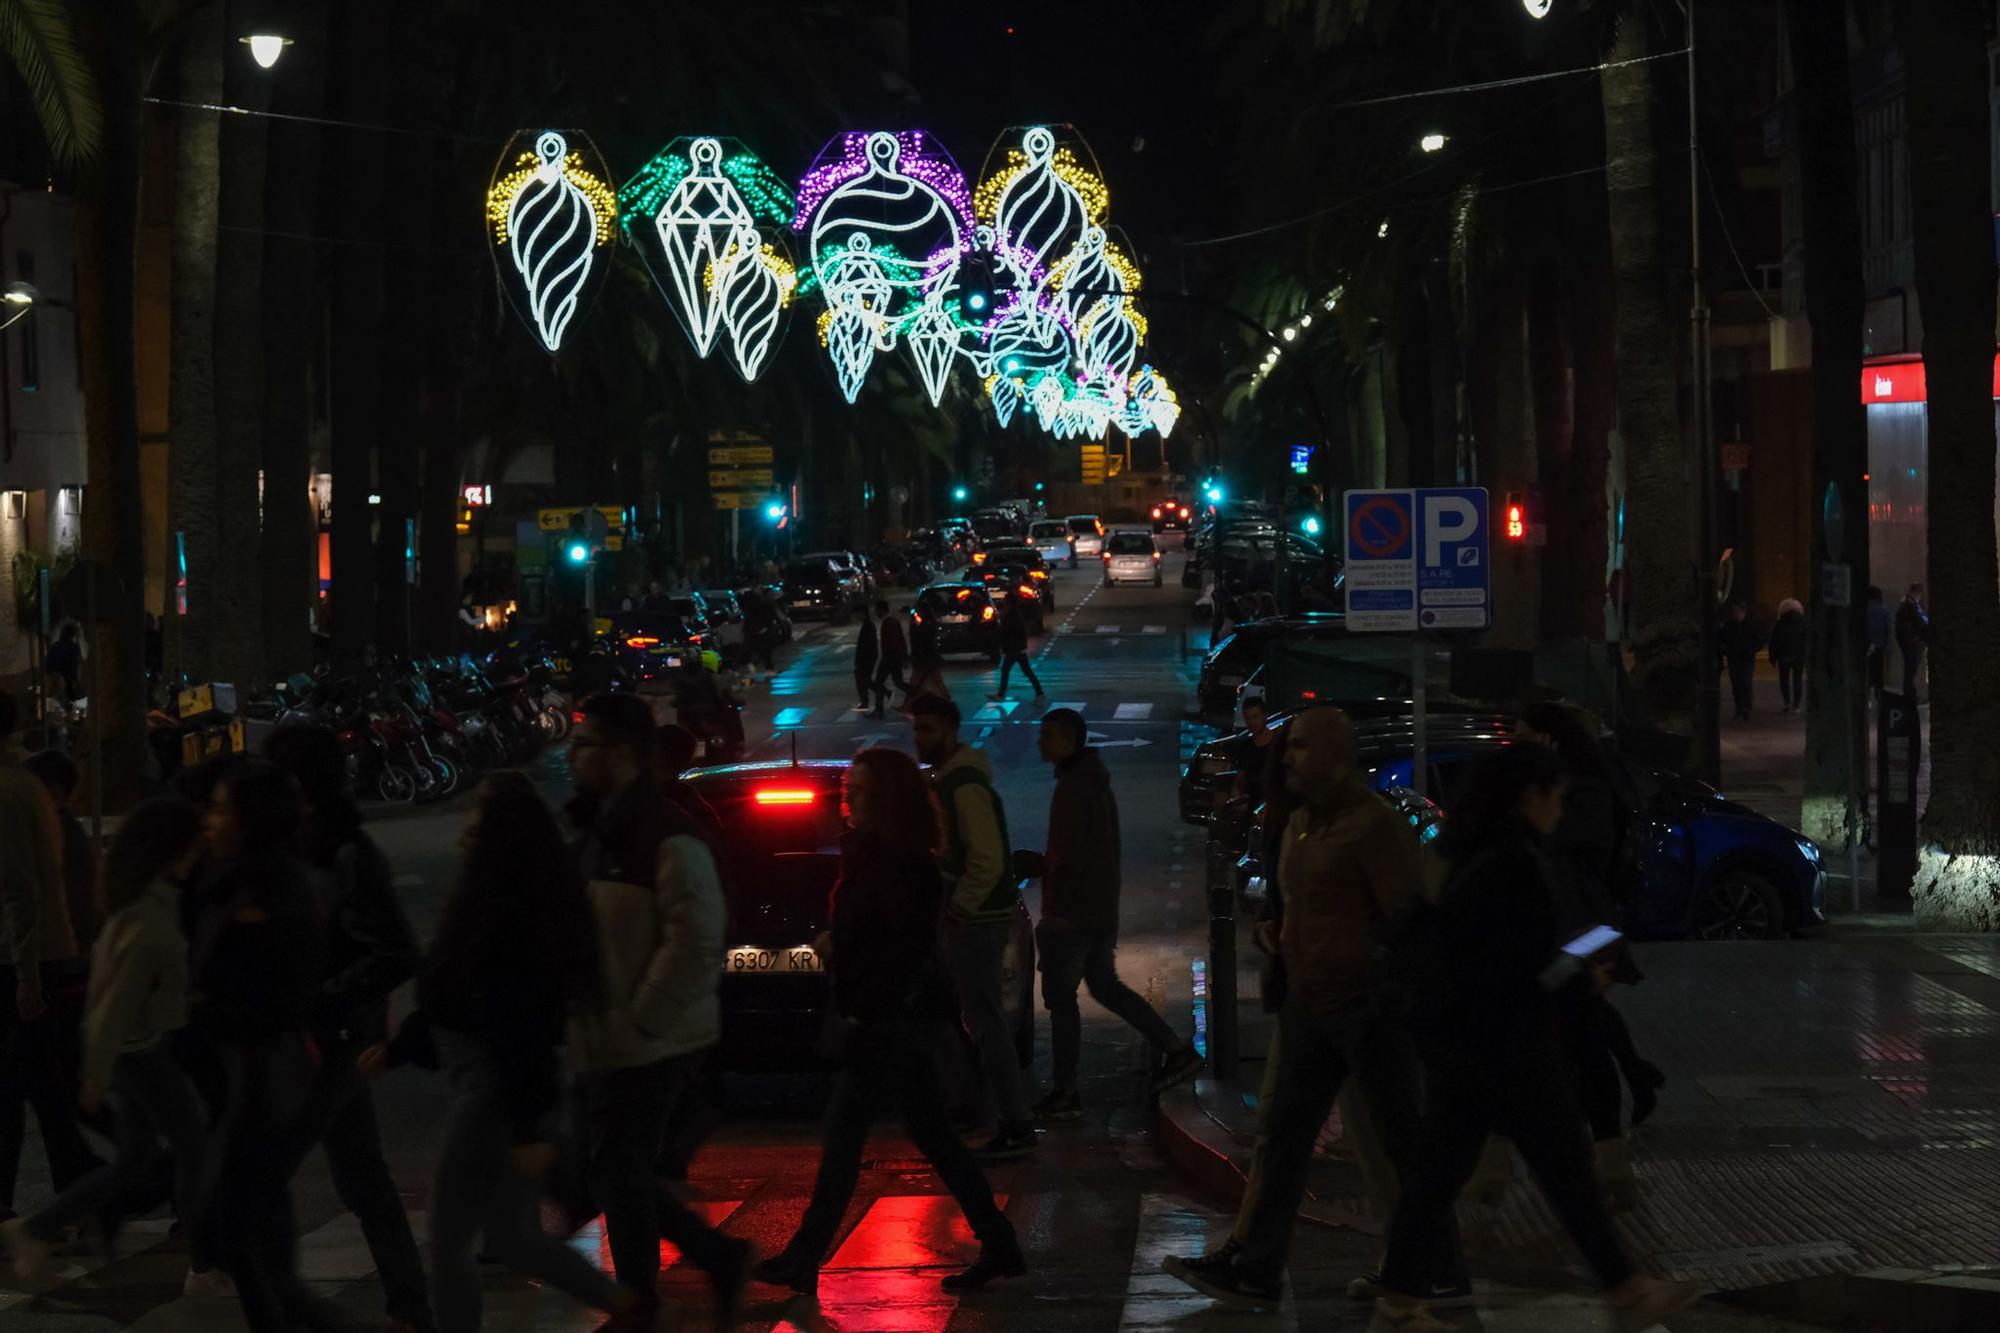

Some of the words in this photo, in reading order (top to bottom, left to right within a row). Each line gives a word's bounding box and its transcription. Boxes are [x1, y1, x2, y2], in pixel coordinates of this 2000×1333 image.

[1424, 496, 1479, 567] P
[1889, 708, 1903, 728] P
[734, 951, 780, 969] 6307
